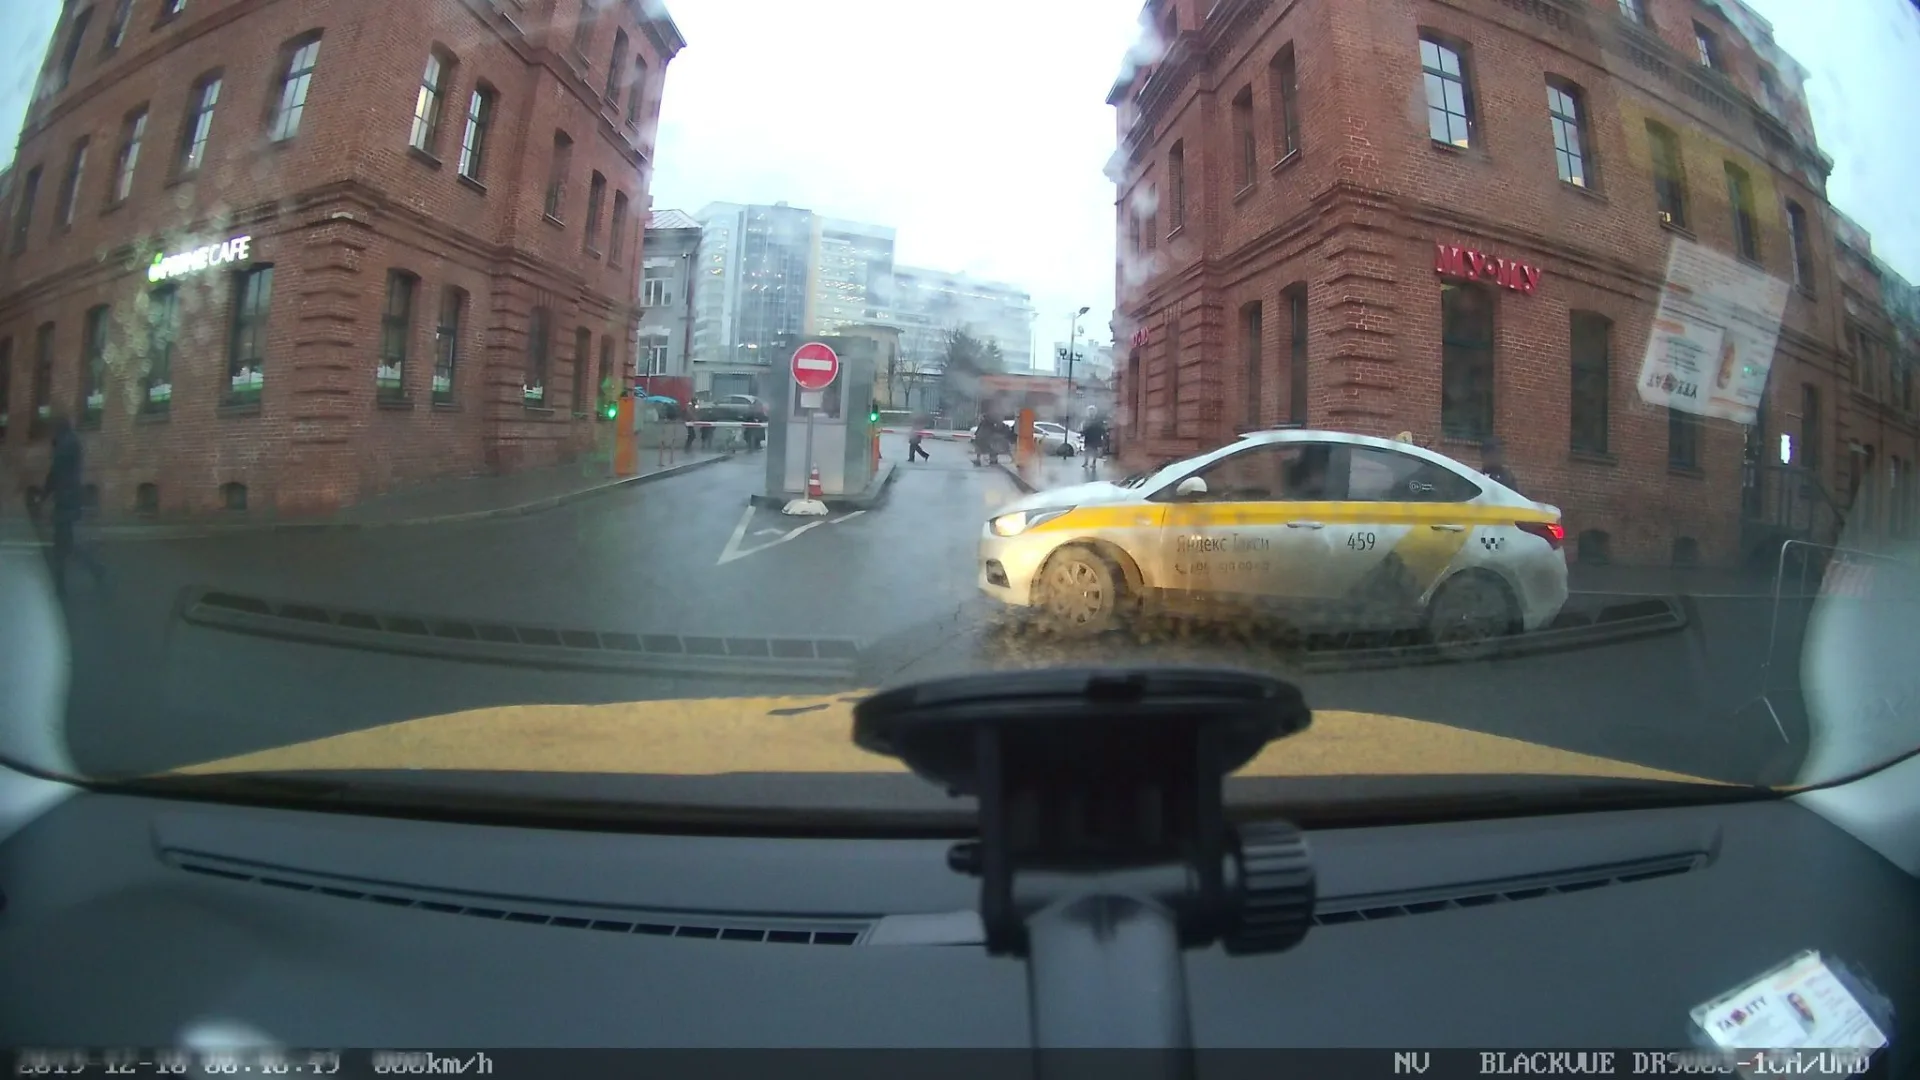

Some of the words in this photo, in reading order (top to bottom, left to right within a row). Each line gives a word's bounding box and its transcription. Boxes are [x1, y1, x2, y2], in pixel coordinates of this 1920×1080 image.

[208, 236, 251, 266] CAFE
[1176, 534, 1228, 553] Яндекс
[1347, 531, 1376, 551] 459
